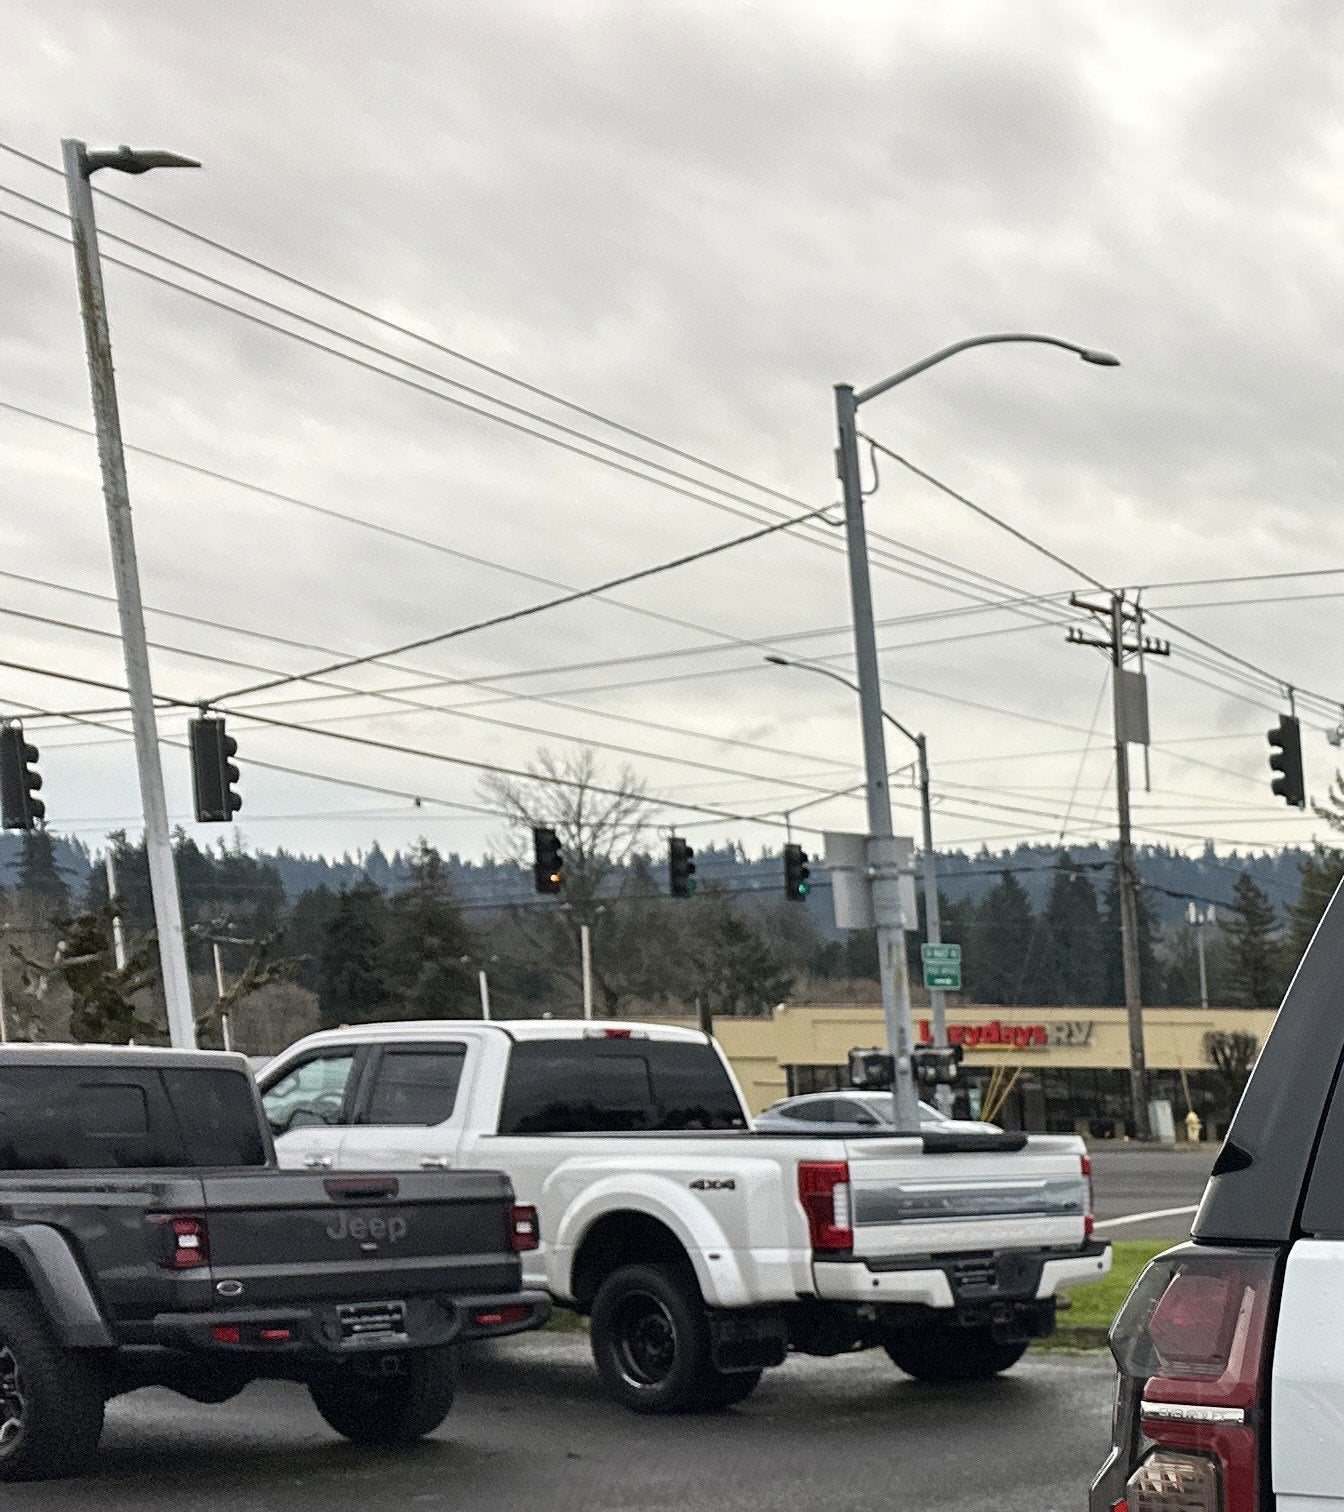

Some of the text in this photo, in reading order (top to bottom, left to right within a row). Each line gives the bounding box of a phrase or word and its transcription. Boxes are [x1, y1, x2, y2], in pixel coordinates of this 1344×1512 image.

[918, 1019, 1095, 1048] Lzydays RV
[326, 1210, 408, 1243] Jeep
